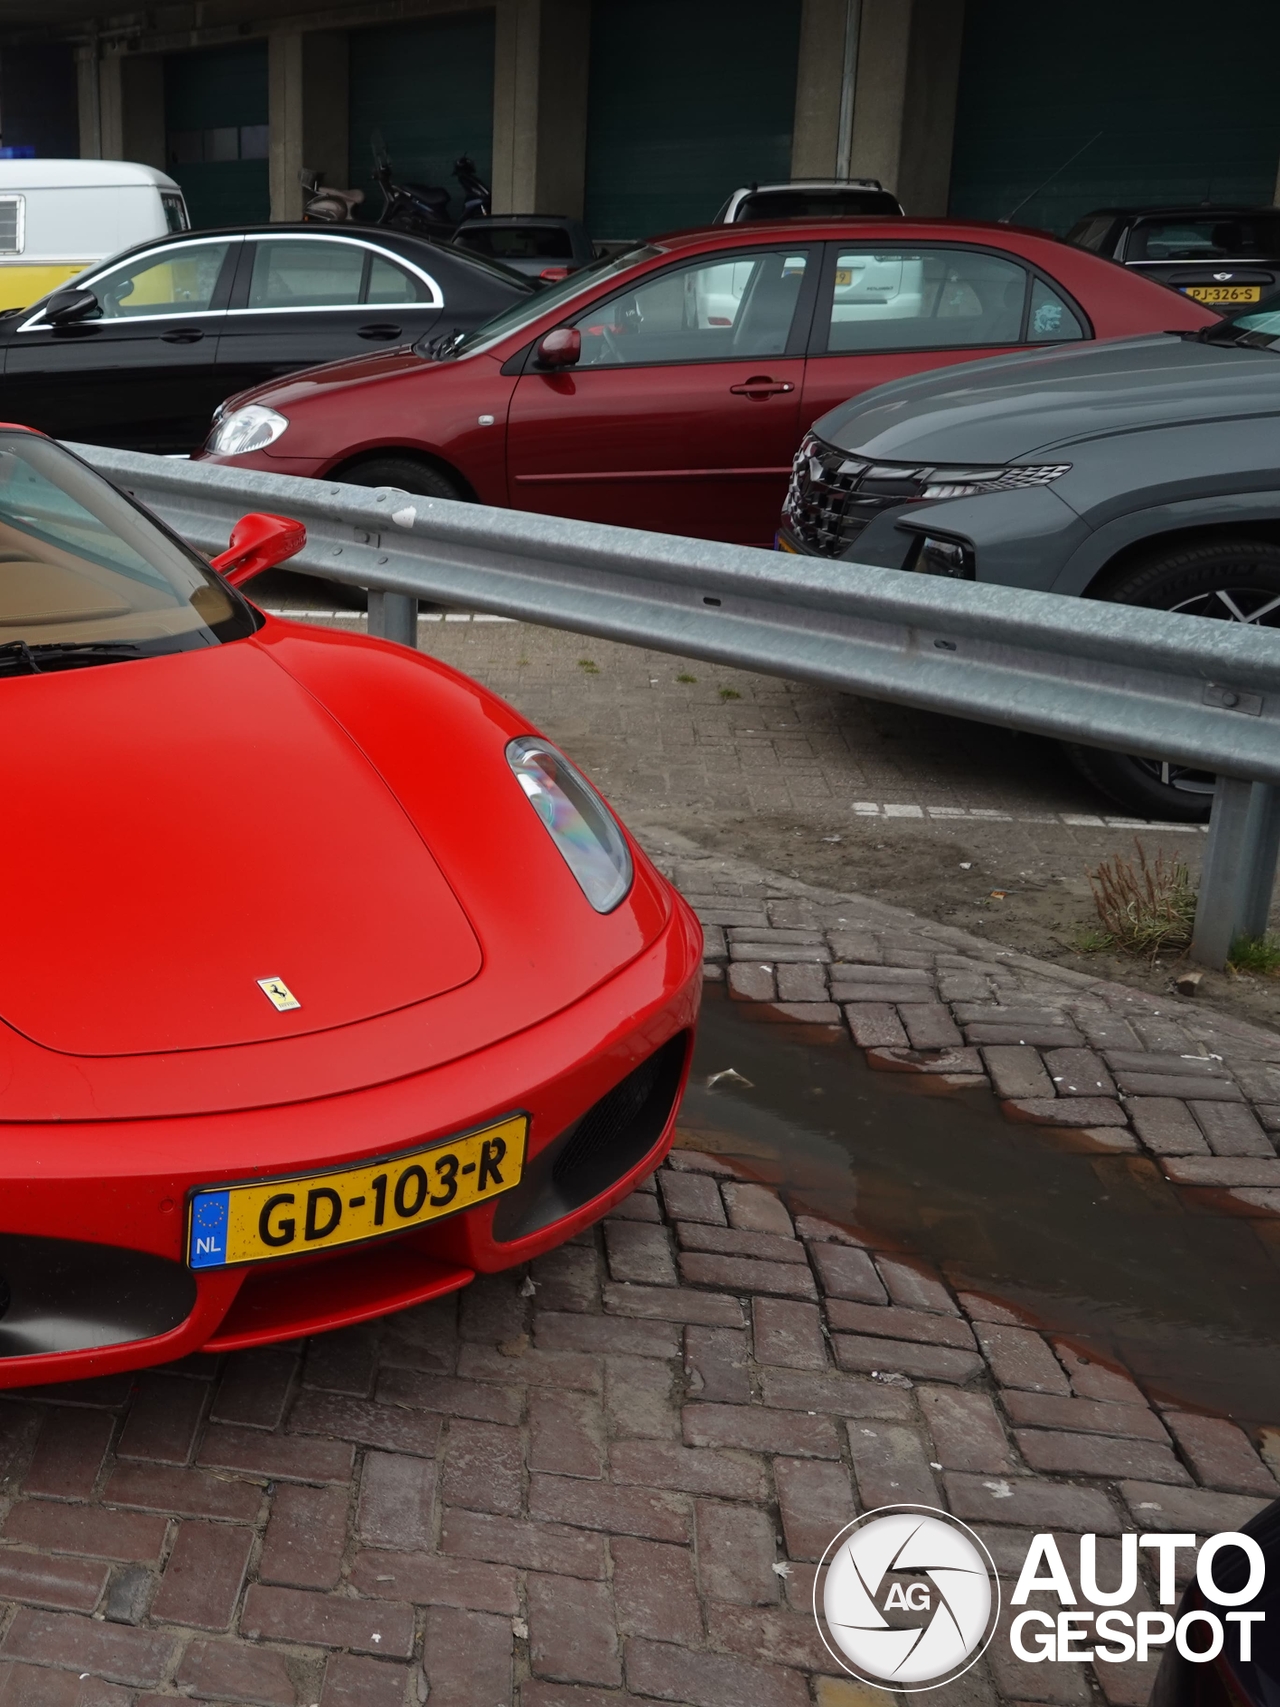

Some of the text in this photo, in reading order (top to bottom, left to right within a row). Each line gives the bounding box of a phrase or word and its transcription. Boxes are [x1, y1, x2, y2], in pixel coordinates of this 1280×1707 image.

[1191, 288, 1253, 301] PJ-326-S
[257, 1136, 507, 1247] GD-103-R
[196, 1236, 222, 1255] NL
